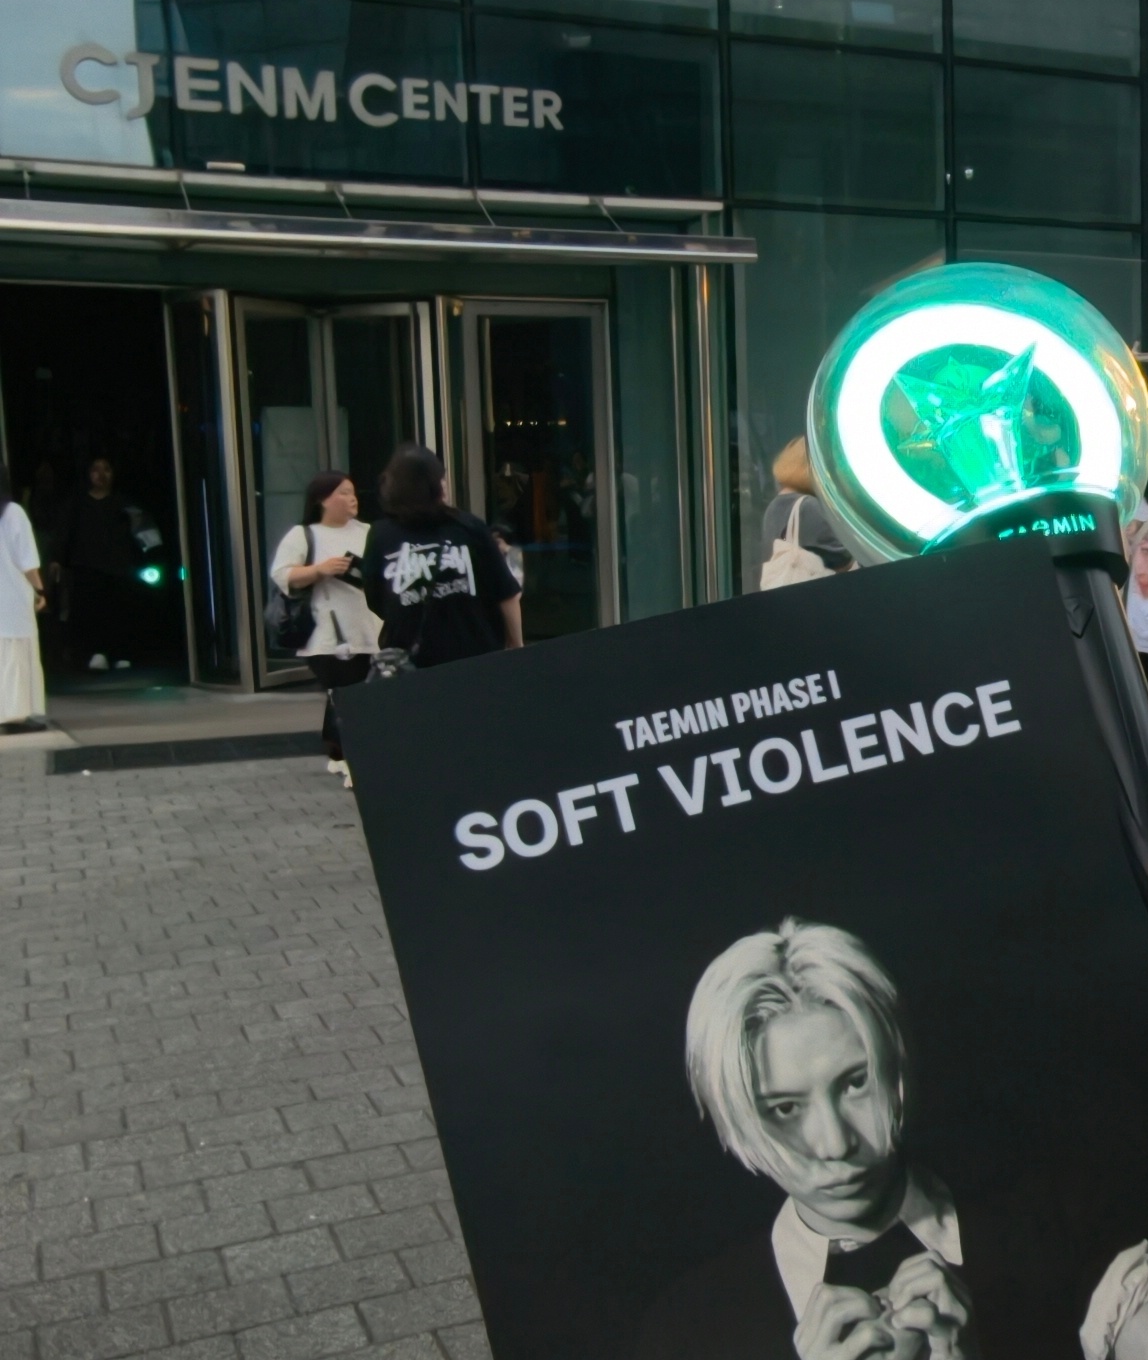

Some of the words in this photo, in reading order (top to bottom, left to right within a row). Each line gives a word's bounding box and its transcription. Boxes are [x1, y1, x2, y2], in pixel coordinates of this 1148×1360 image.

[59, 42, 161, 121] CJ
[174, 55, 338, 123] ENM
[348, 73, 565, 131] CENTER
[615, 698, 729, 751] TAEMIN
[730, 673, 826, 726] PHASE
[454, 773, 640, 871] SOFT
[656, 680, 1022, 817] VIOLENCE
